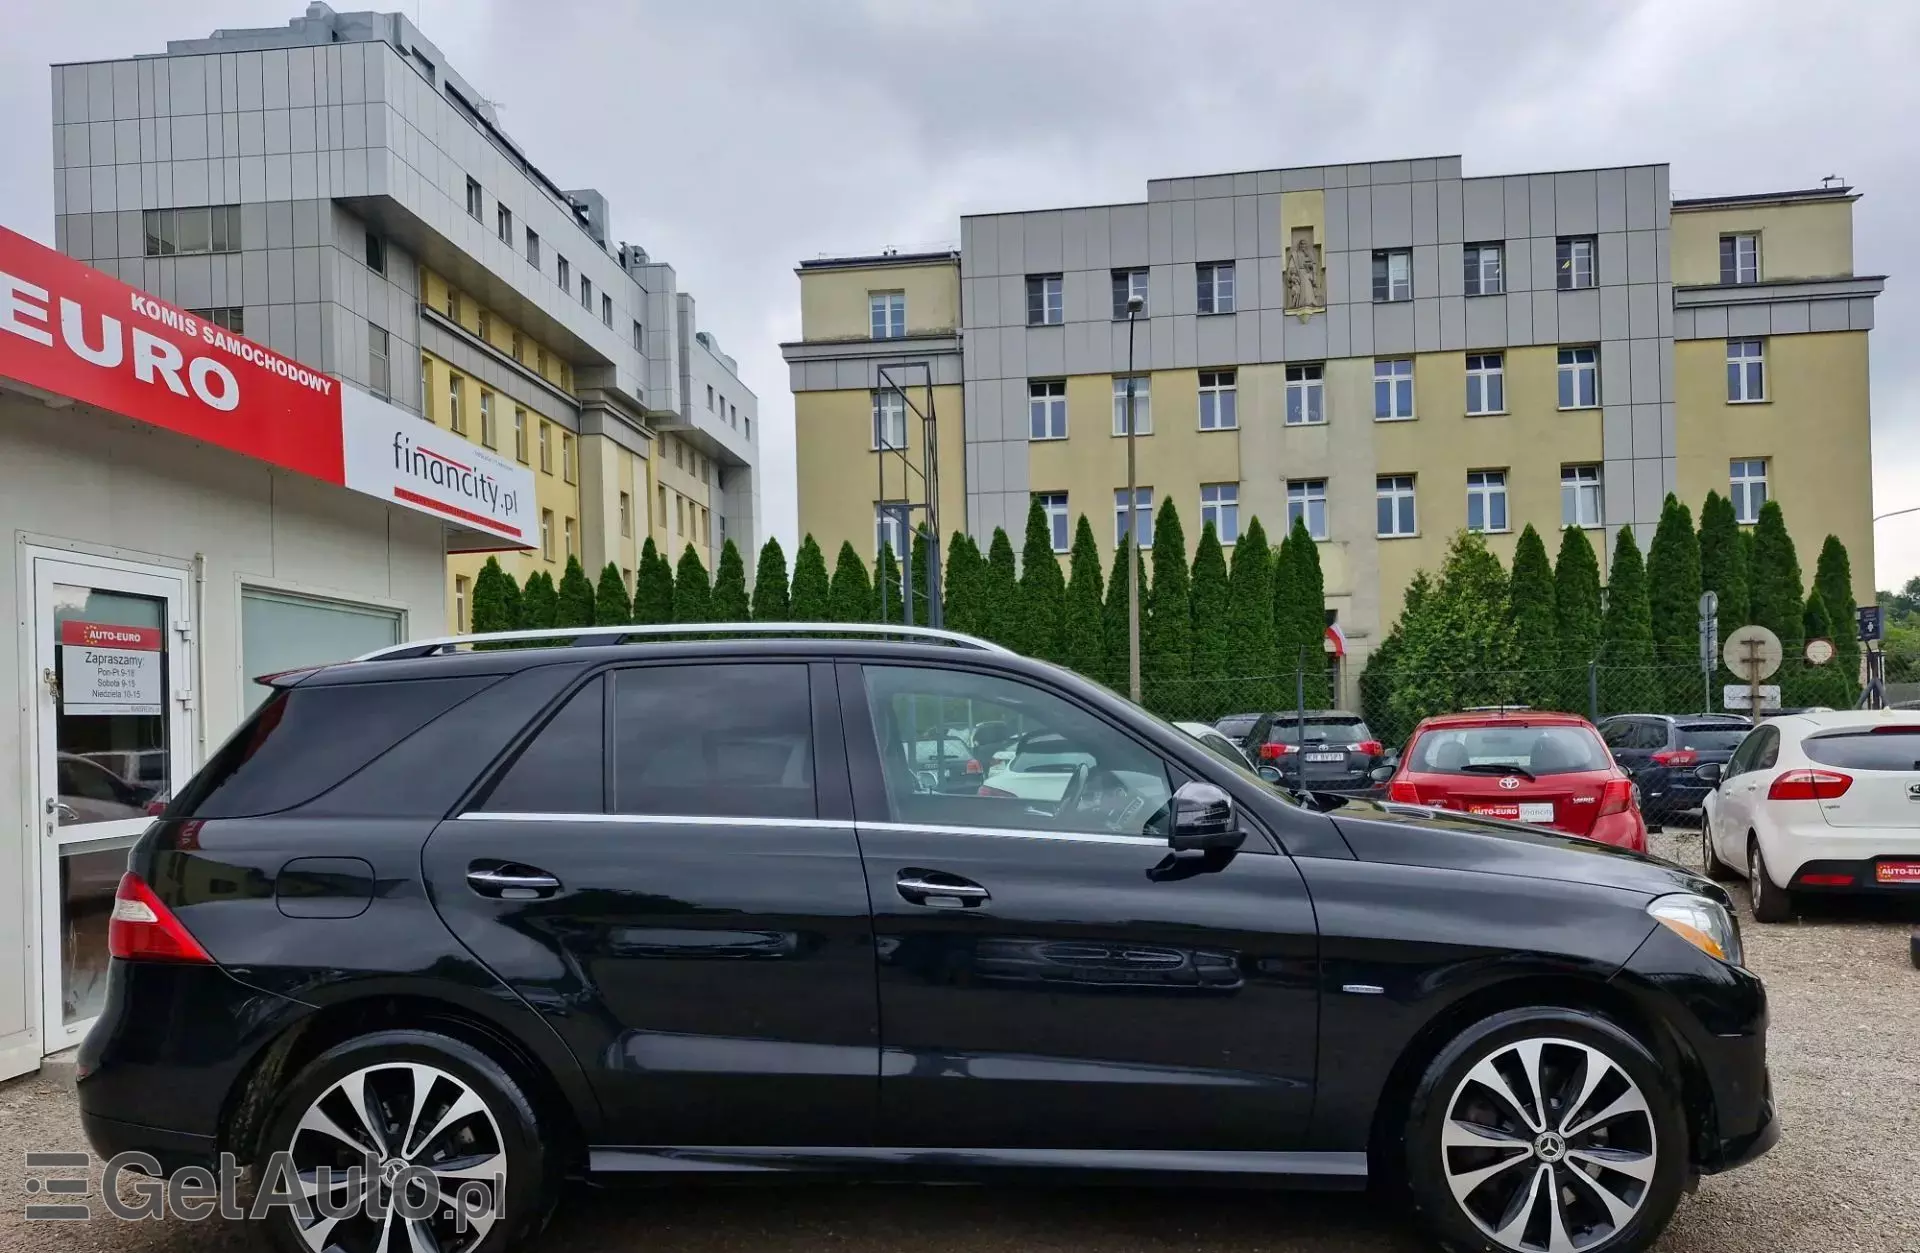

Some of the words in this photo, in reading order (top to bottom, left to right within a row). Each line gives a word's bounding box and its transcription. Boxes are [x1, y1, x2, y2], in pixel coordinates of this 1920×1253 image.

[0, 271, 240, 412] EURO
[131, 292, 198, 337] KOMIS
[202, 325, 333, 396] SAMOCHODOWY
[393, 432, 518, 516] financity.pl
[89, 630, 141, 642] AUTO-EURO
